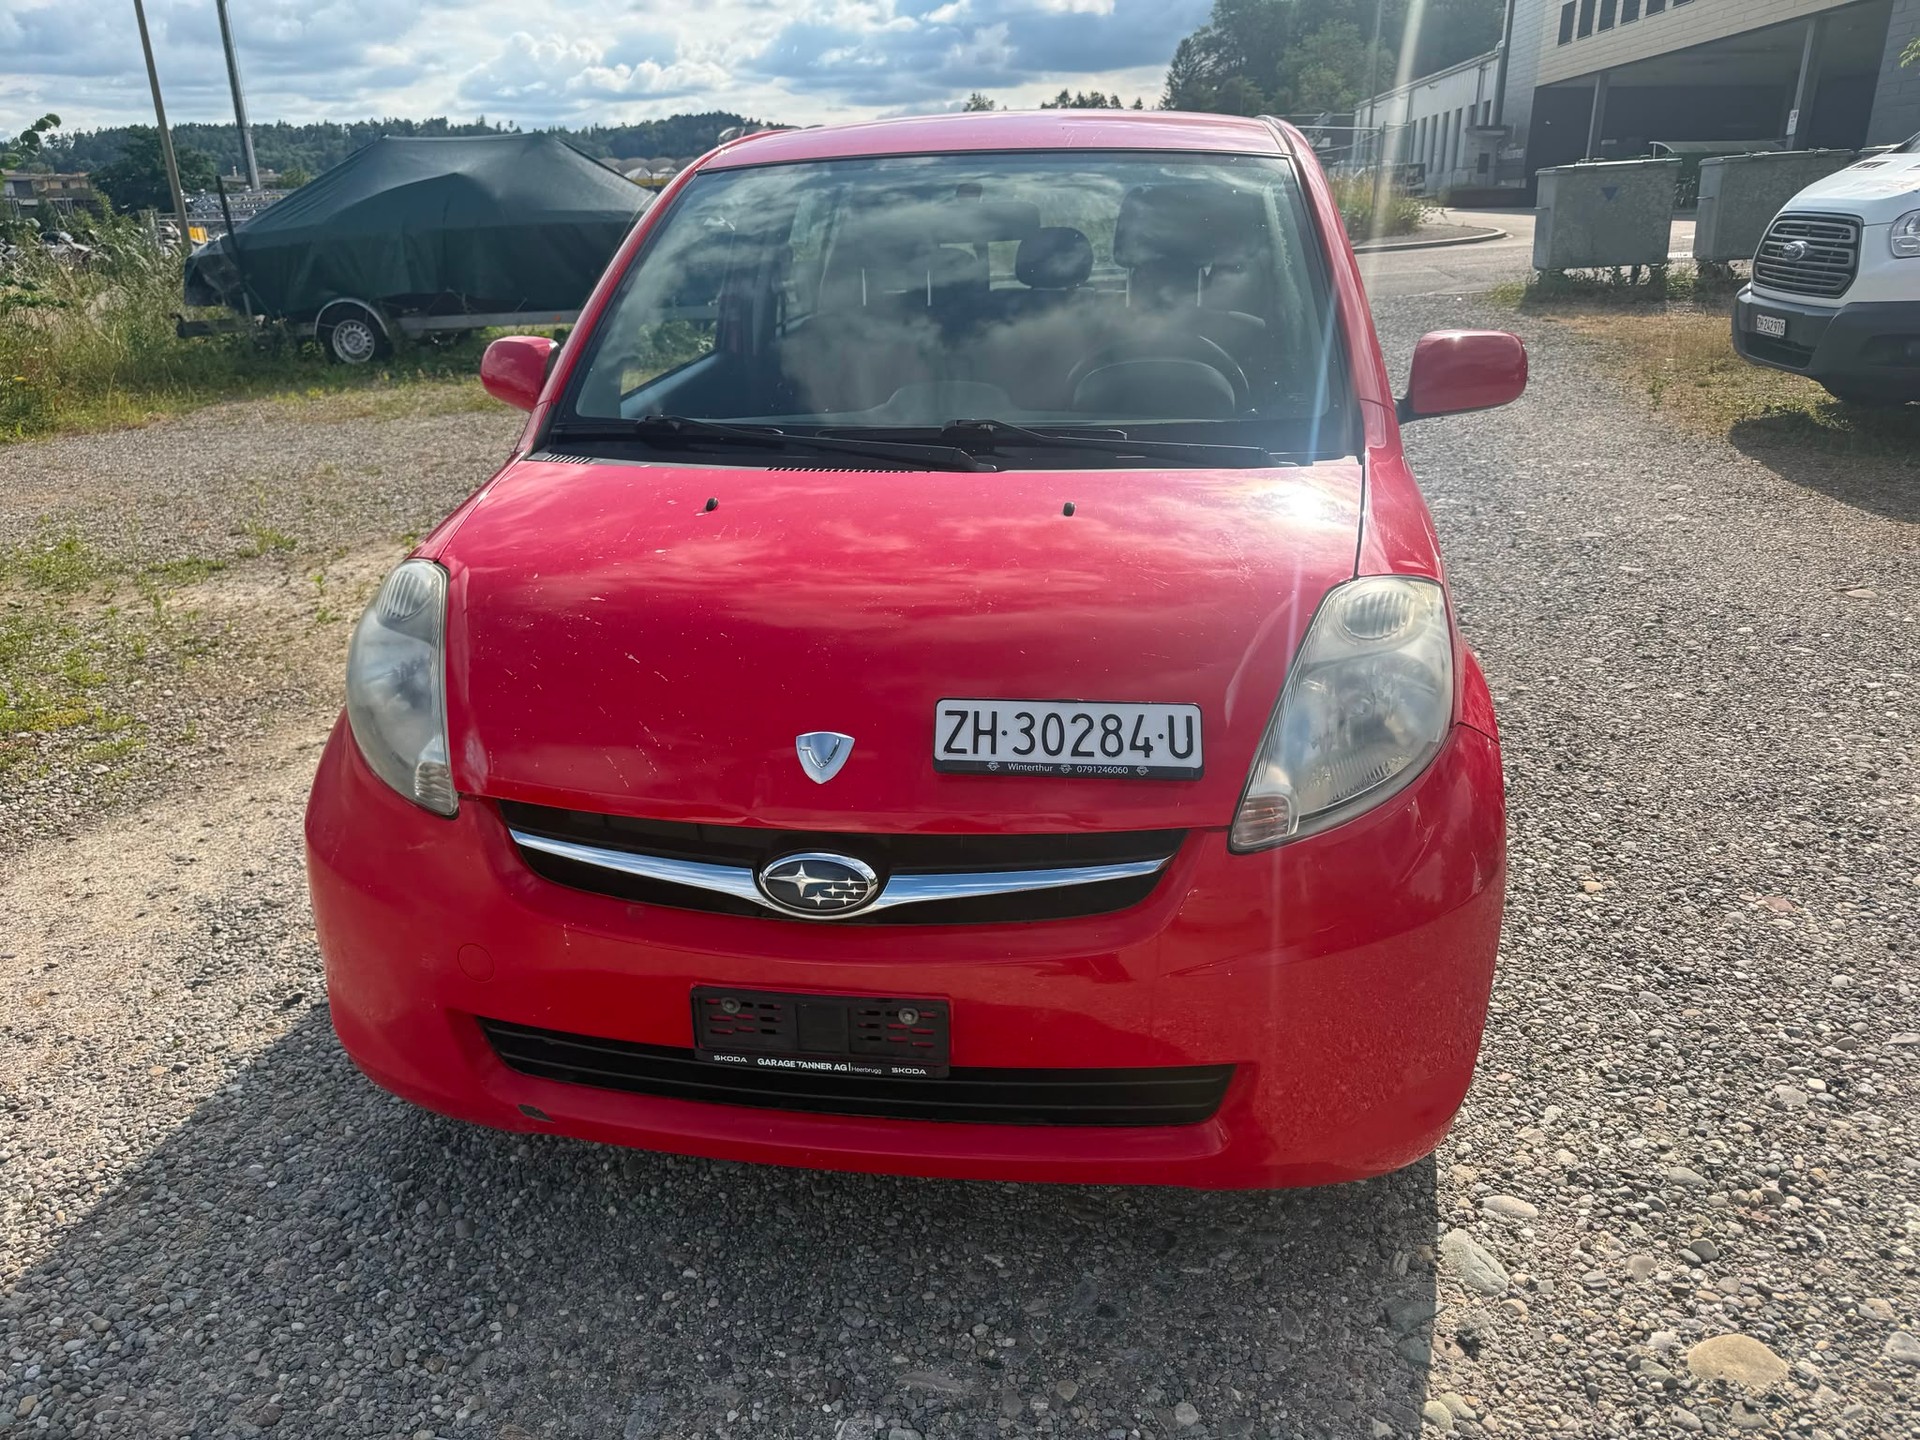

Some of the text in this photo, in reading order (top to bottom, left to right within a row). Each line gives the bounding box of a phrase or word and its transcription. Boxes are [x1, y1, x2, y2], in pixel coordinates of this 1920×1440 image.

[1008, 763, 1128, 774] Winterthur 0791246060
[757, 1058, 796, 1068] GARAGE
[796, 1061, 832, 1071] TANNER
[833, 1063, 847, 1071] AG
[851, 1066, 882, 1074] Heerbrugg
